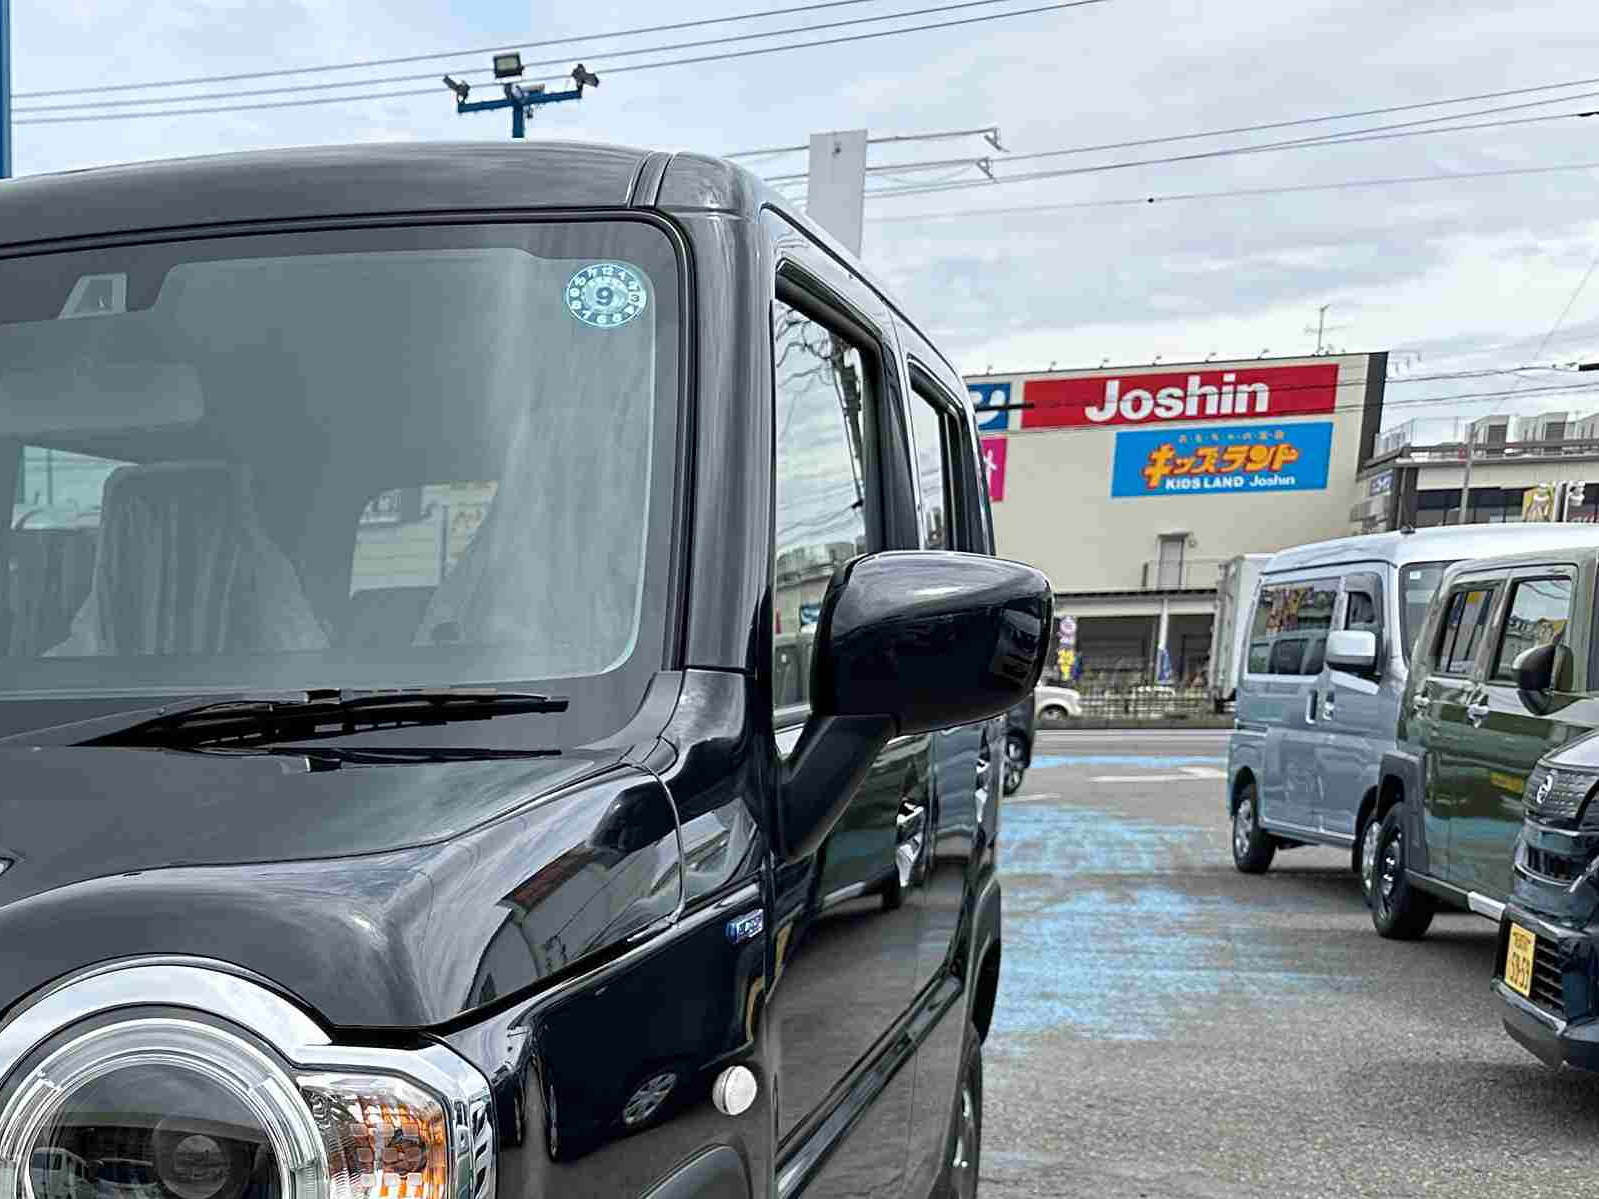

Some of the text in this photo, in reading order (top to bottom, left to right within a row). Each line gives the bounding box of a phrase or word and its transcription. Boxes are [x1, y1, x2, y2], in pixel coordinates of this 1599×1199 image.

[595, 286, 613, 306] 9
[1084, 373, 1270, 423] Joshin
[1141, 442, 1299, 489] キッズランド
[1165, 474, 1296, 490] KIDS LAND Joshin
